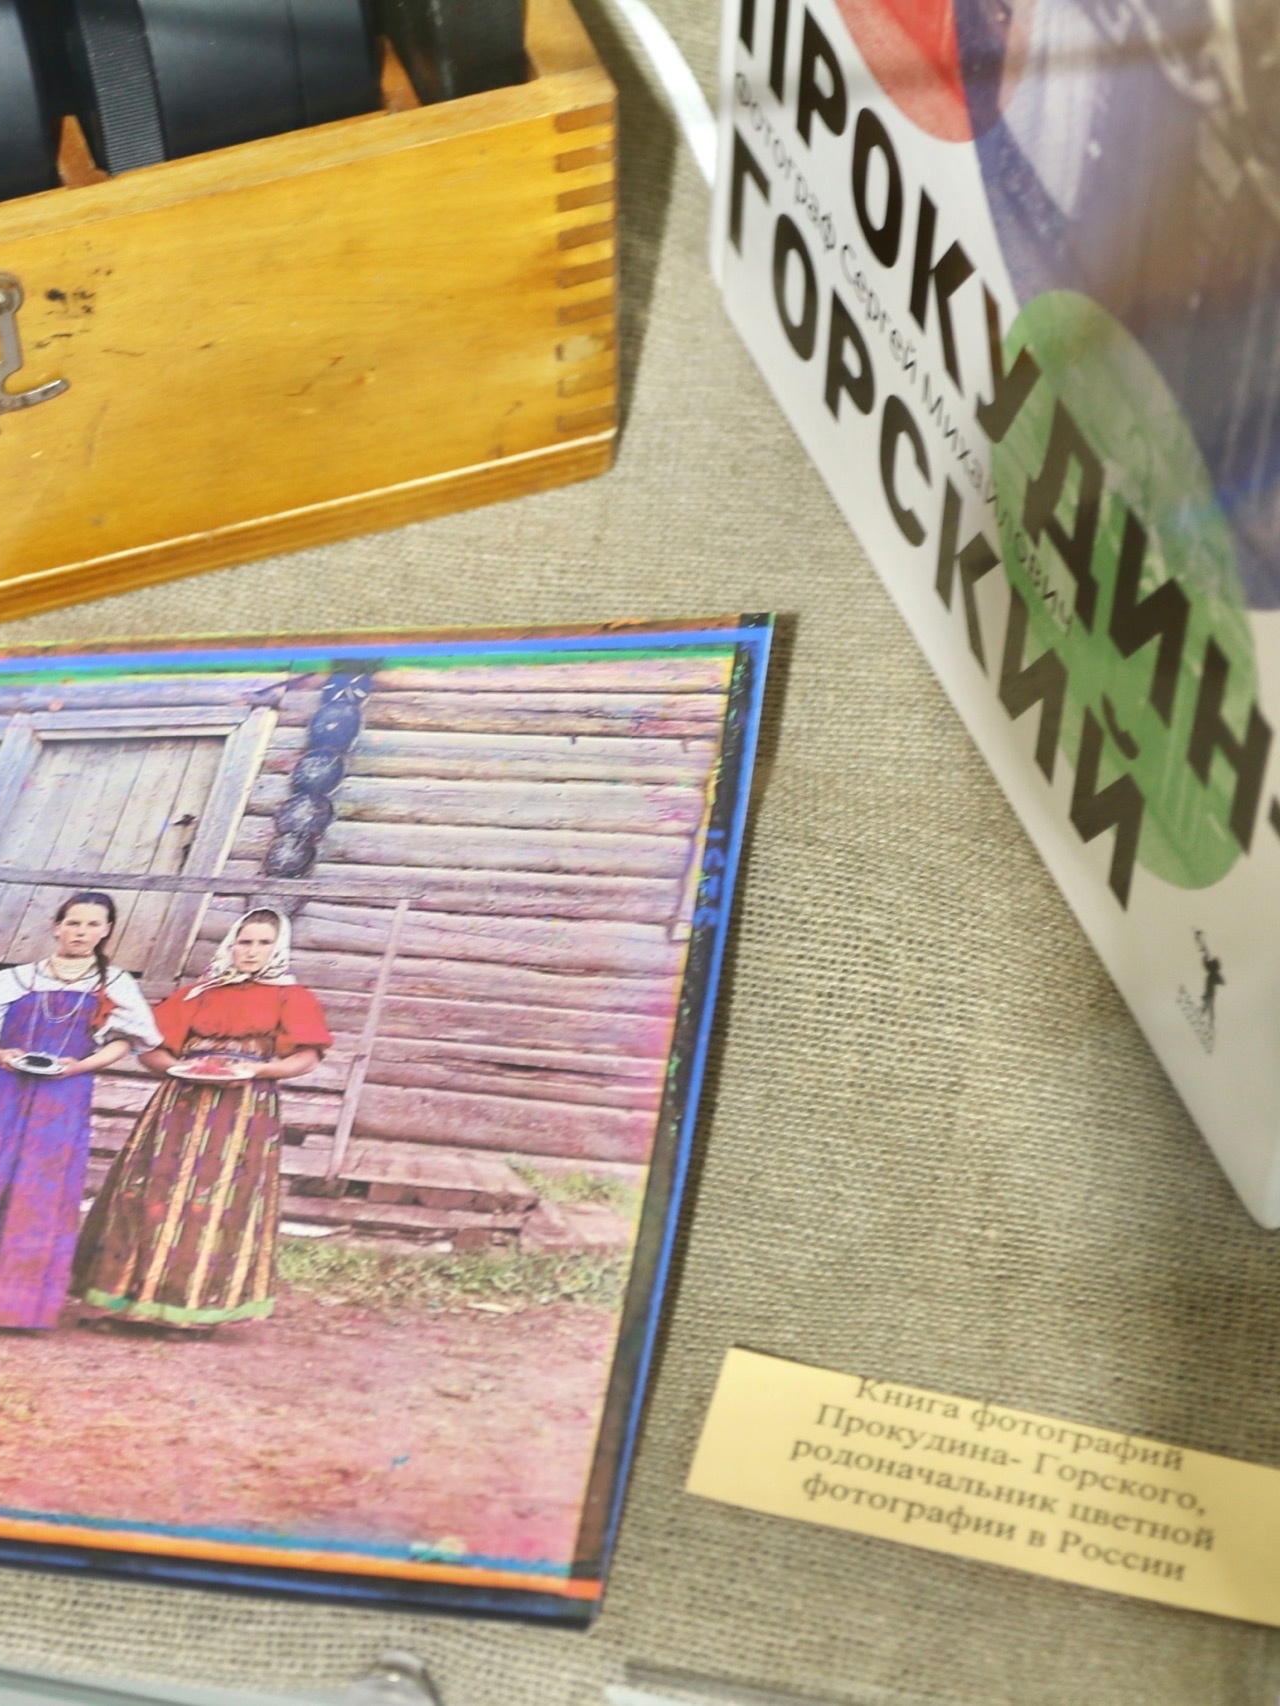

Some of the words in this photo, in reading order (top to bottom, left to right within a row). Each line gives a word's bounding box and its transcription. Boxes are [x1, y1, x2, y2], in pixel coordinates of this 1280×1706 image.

[840, 243, 917, 386] Сергей
[726, 122, 1146, 913] ГОРСКИЙ
[815, 1403, 1021, 1466] Прокудина-
[1033, 1452, 1207, 1517] Горского,
[854, 1377, 960, 1419] Книга
[971, 1400, 1184, 1472] фотографий
[790, 1439, 1059, 1514] родоначальник
[1068, 1502, 1215, 1552] цветной
[802, 1473, 1017, 1542] фотографии
[1026, 1529, 1048, 1549] в
[1058, 1530, 1186, 1581] России
